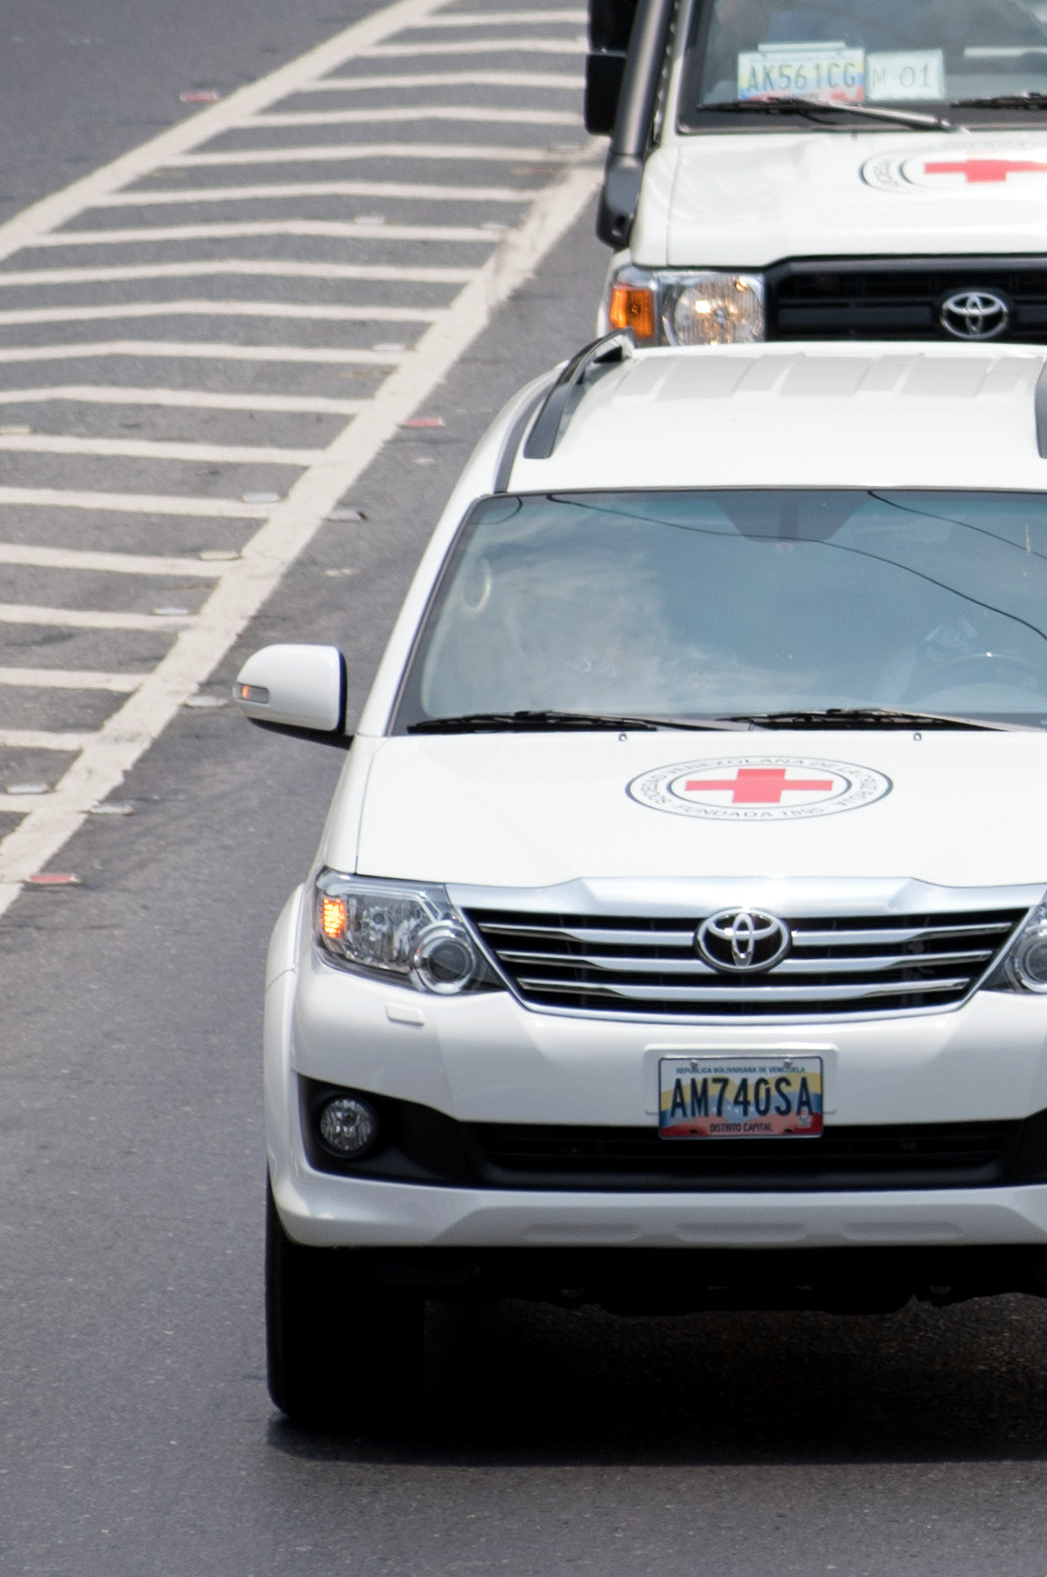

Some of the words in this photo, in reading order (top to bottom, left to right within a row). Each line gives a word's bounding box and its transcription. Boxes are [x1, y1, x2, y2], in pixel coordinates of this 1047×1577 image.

[669, 1076, 814, 1118] AM740SA
[709, 1123, 742, 1133] DISTRITO
[743, 1122, 773, 1132] CAPITAL
